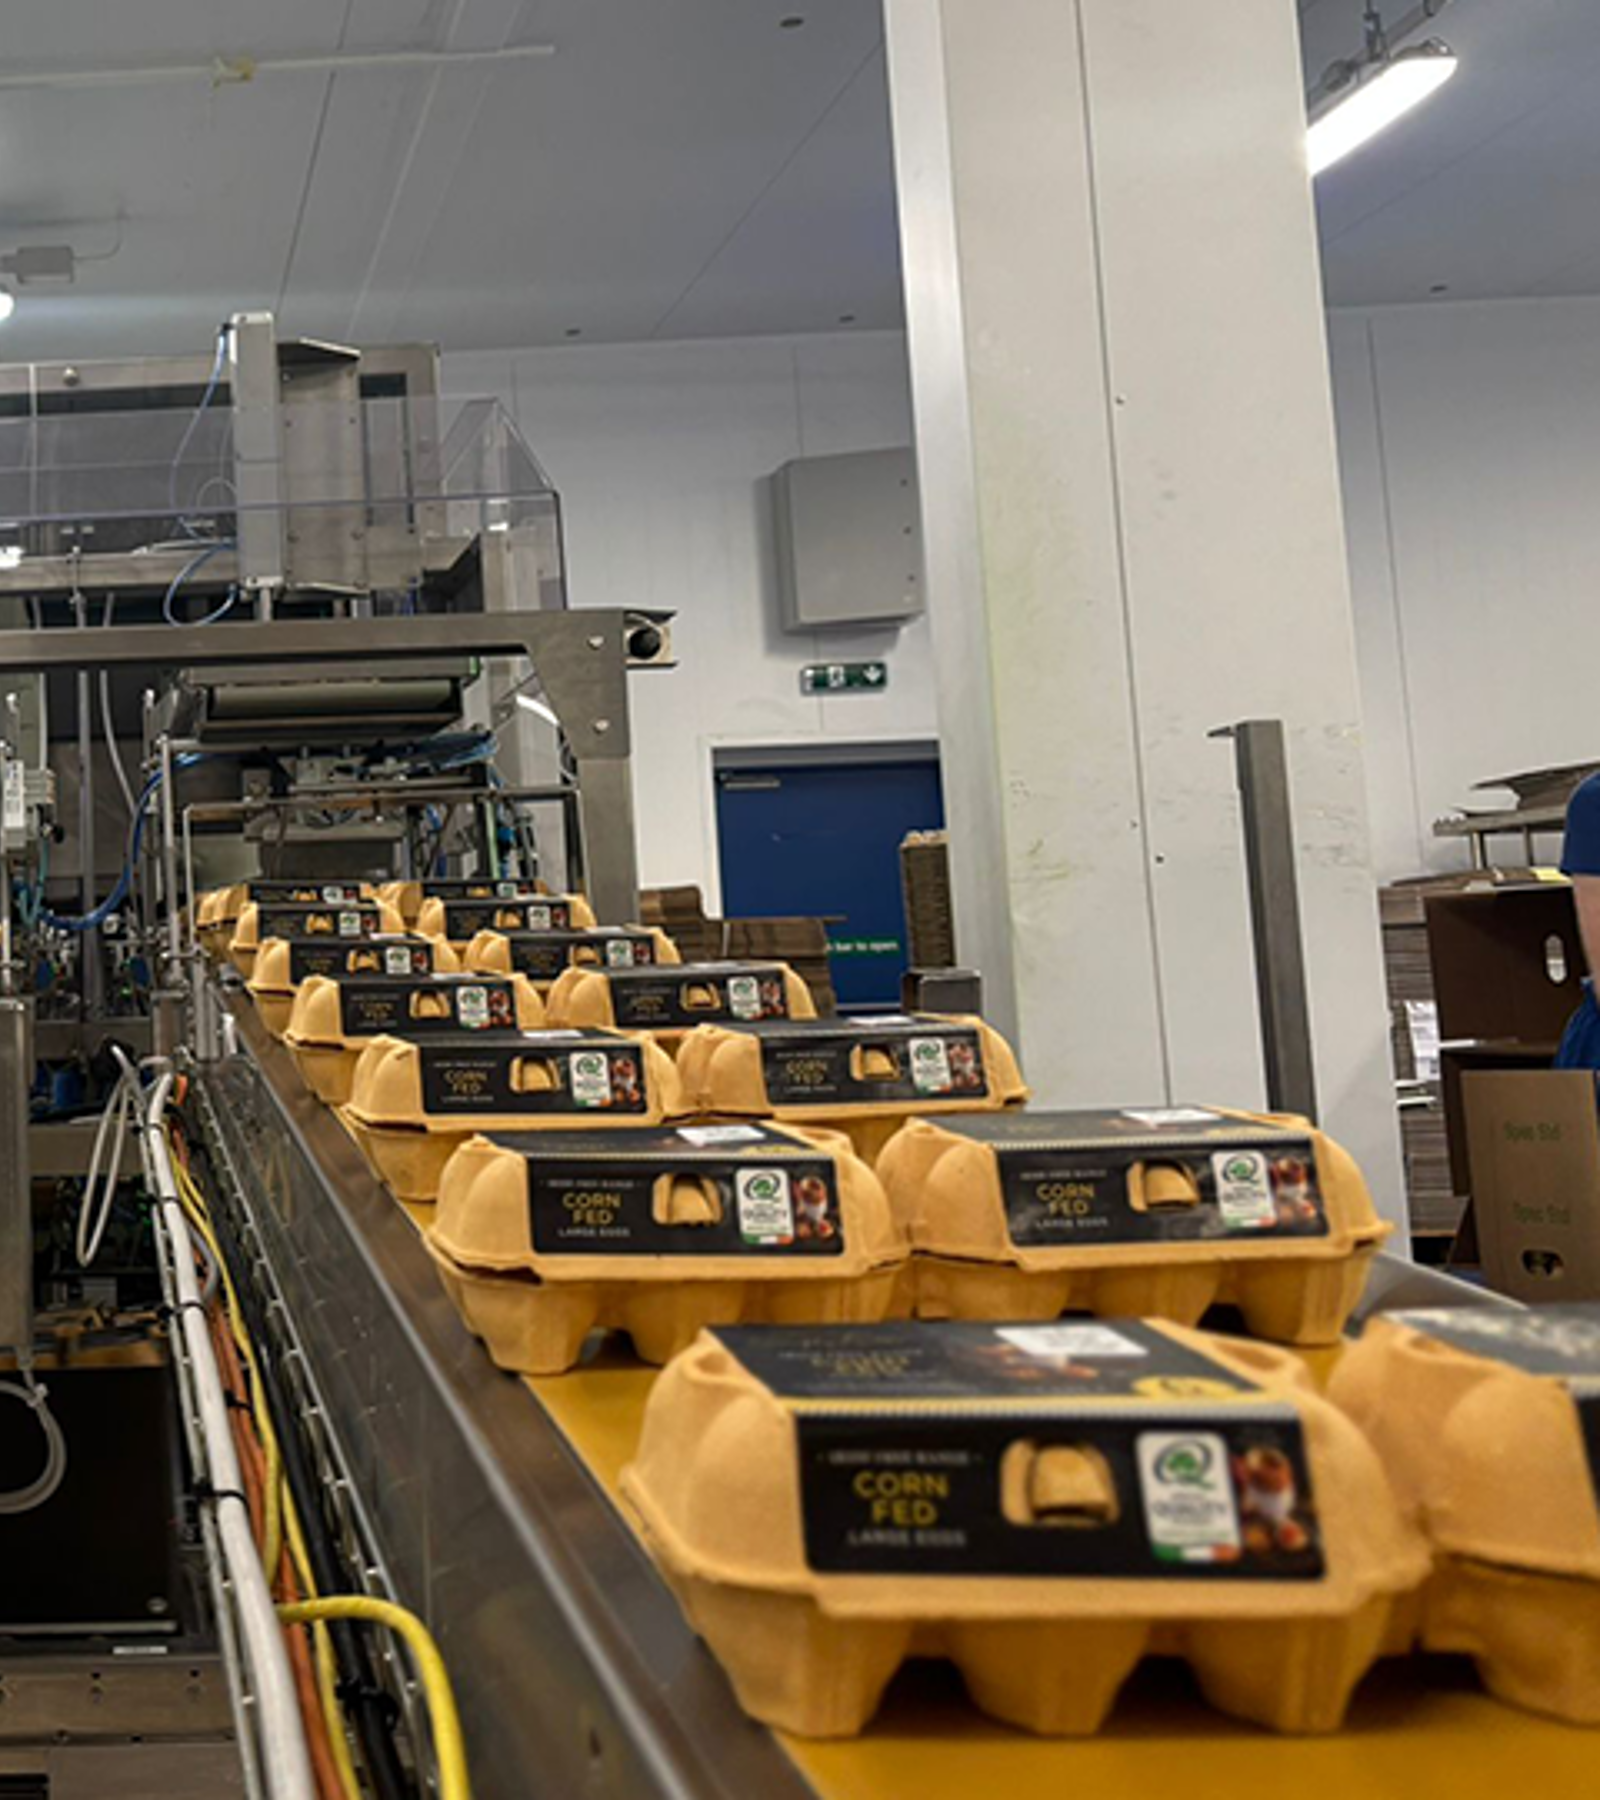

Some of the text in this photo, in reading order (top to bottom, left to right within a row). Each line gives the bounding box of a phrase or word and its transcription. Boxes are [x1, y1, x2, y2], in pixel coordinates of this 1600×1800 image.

[562, 1192, 621, 1209] CORN
[852, 1470, 950, 1498] CORN
[872, 1499, 938, 1527] FED
